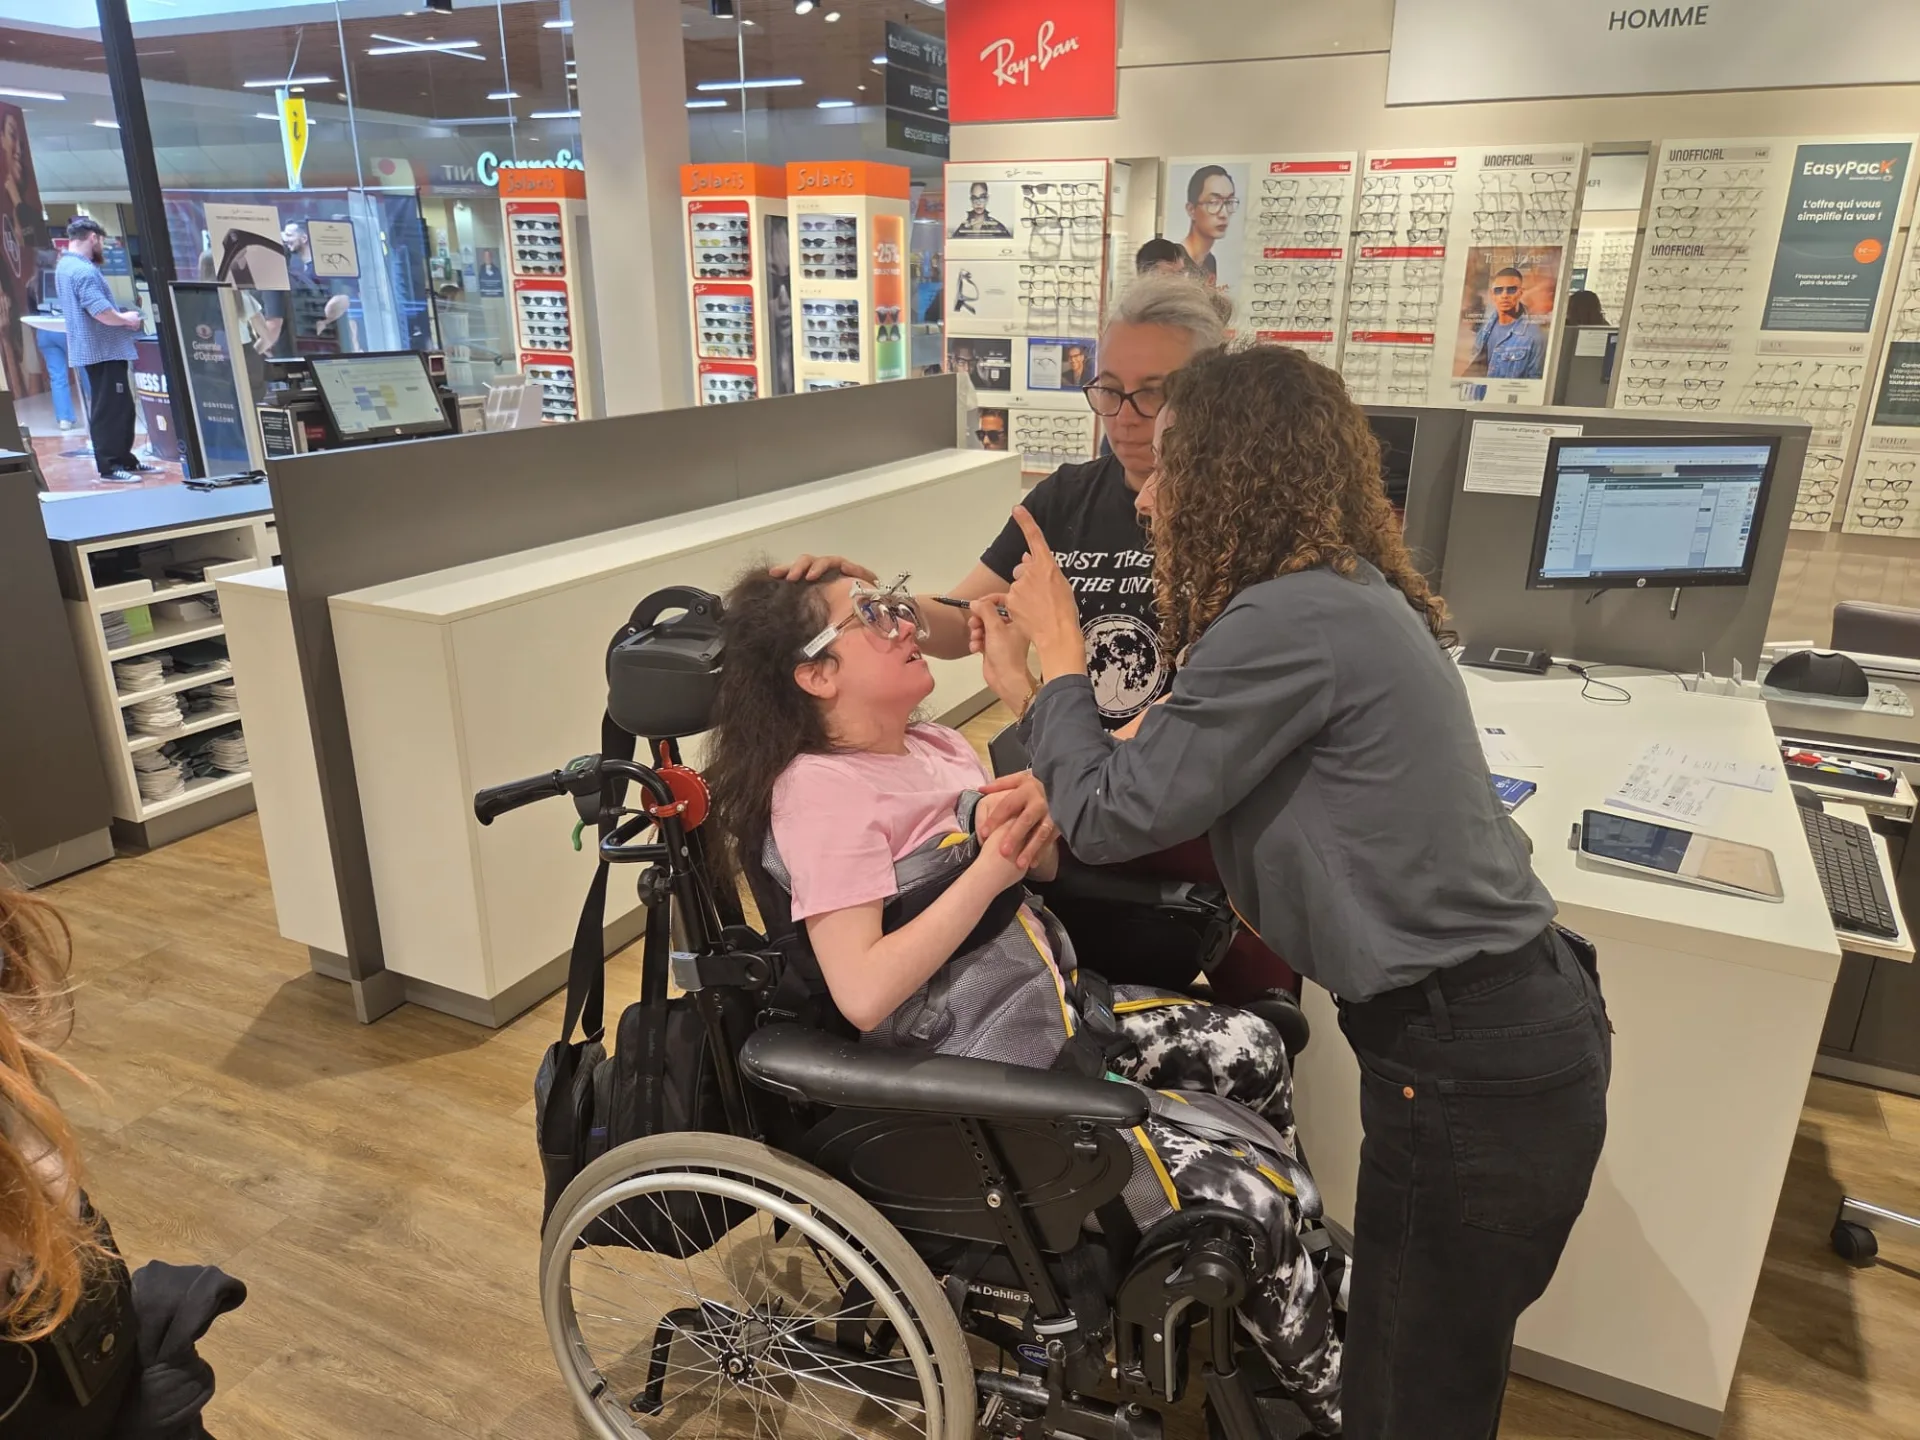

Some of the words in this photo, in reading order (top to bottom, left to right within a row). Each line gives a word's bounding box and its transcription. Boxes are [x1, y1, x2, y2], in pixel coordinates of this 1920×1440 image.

[1608, 5, 1709, 31] HOMME
[1484, 154, 1534, 167] UNOFFICIAL
[1669, 148, 1724, 162] UNOFFICIAL
[691, 170, 744, 192] Solaris
[797, 168, 854, 191] Solaris
[1803, 200, 1834, 209] L'offre
[1836, 199, 1854, 210] qui
[1856, 200, 1881, 208] vous
[1797, 212, 1841, 223] simplifie
[1843, 212, 1853, 221] la
[1856, 213, 1875, 221] vue
[1651, 244, 1705, 256] UNOFFICIAL
[1050, 550, 1108, 570] RUST
[1113, 550, 1155, 569] THE
[1068, 577, 1115, 593] THE
[983, 1286, 1021, 1301] Dahlia
[1022, 1293, 1034, 1304] 3
